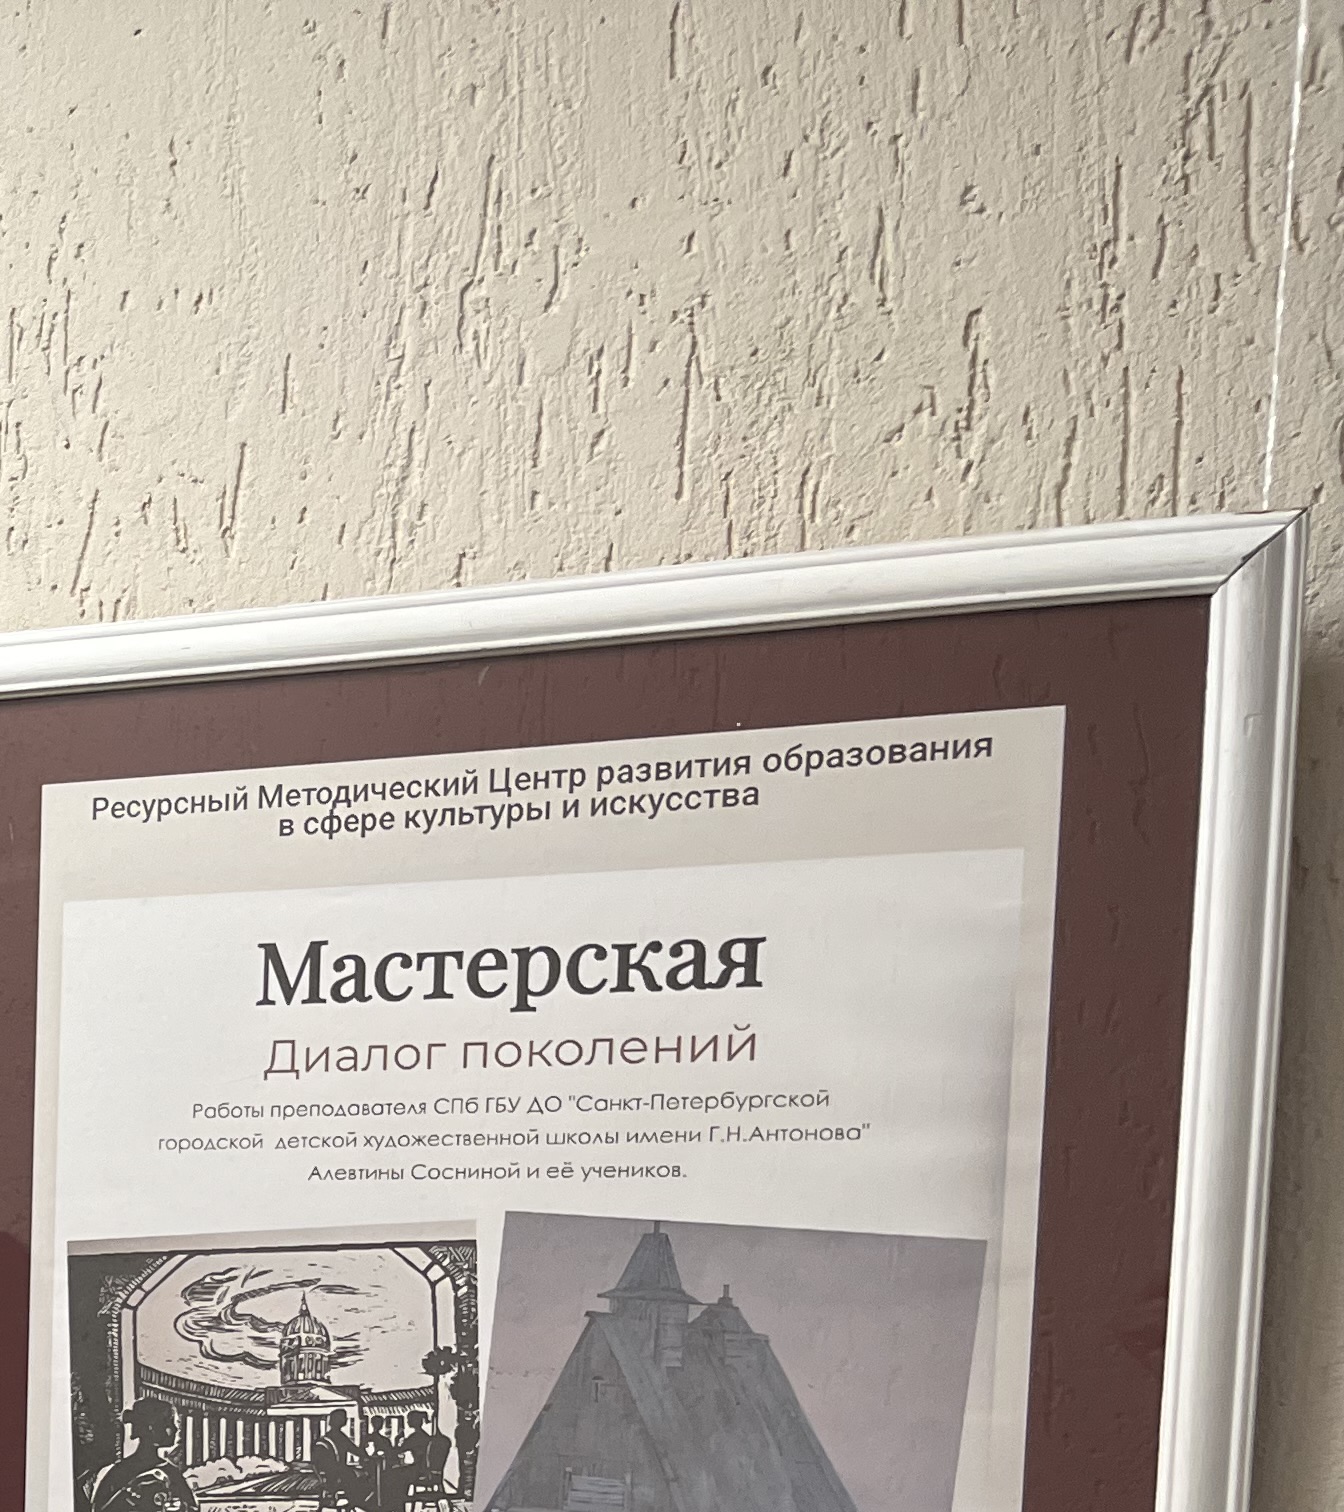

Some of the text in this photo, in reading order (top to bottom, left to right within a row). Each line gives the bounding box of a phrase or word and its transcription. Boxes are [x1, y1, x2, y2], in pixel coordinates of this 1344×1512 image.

[92, 736, 993, 823] Ресурсный Методический Центр развития образования
[278, 784, 760, 840] в сфере культуры и искусства
[255, 936, 767, 1013] Мастерская
[263, 1024, 757, 1080] Диалог поколений
[192, 1089, 830, 1121] Работы преподавателя СПб ГБУ ДО "Санкт-Петербургской
[158, 1122, 871, 1154] городской детской художественной школы имени Г.Н.Антонова"
[307, 1161, 688, 1183] Алевтины Сосниной и её учеников.
